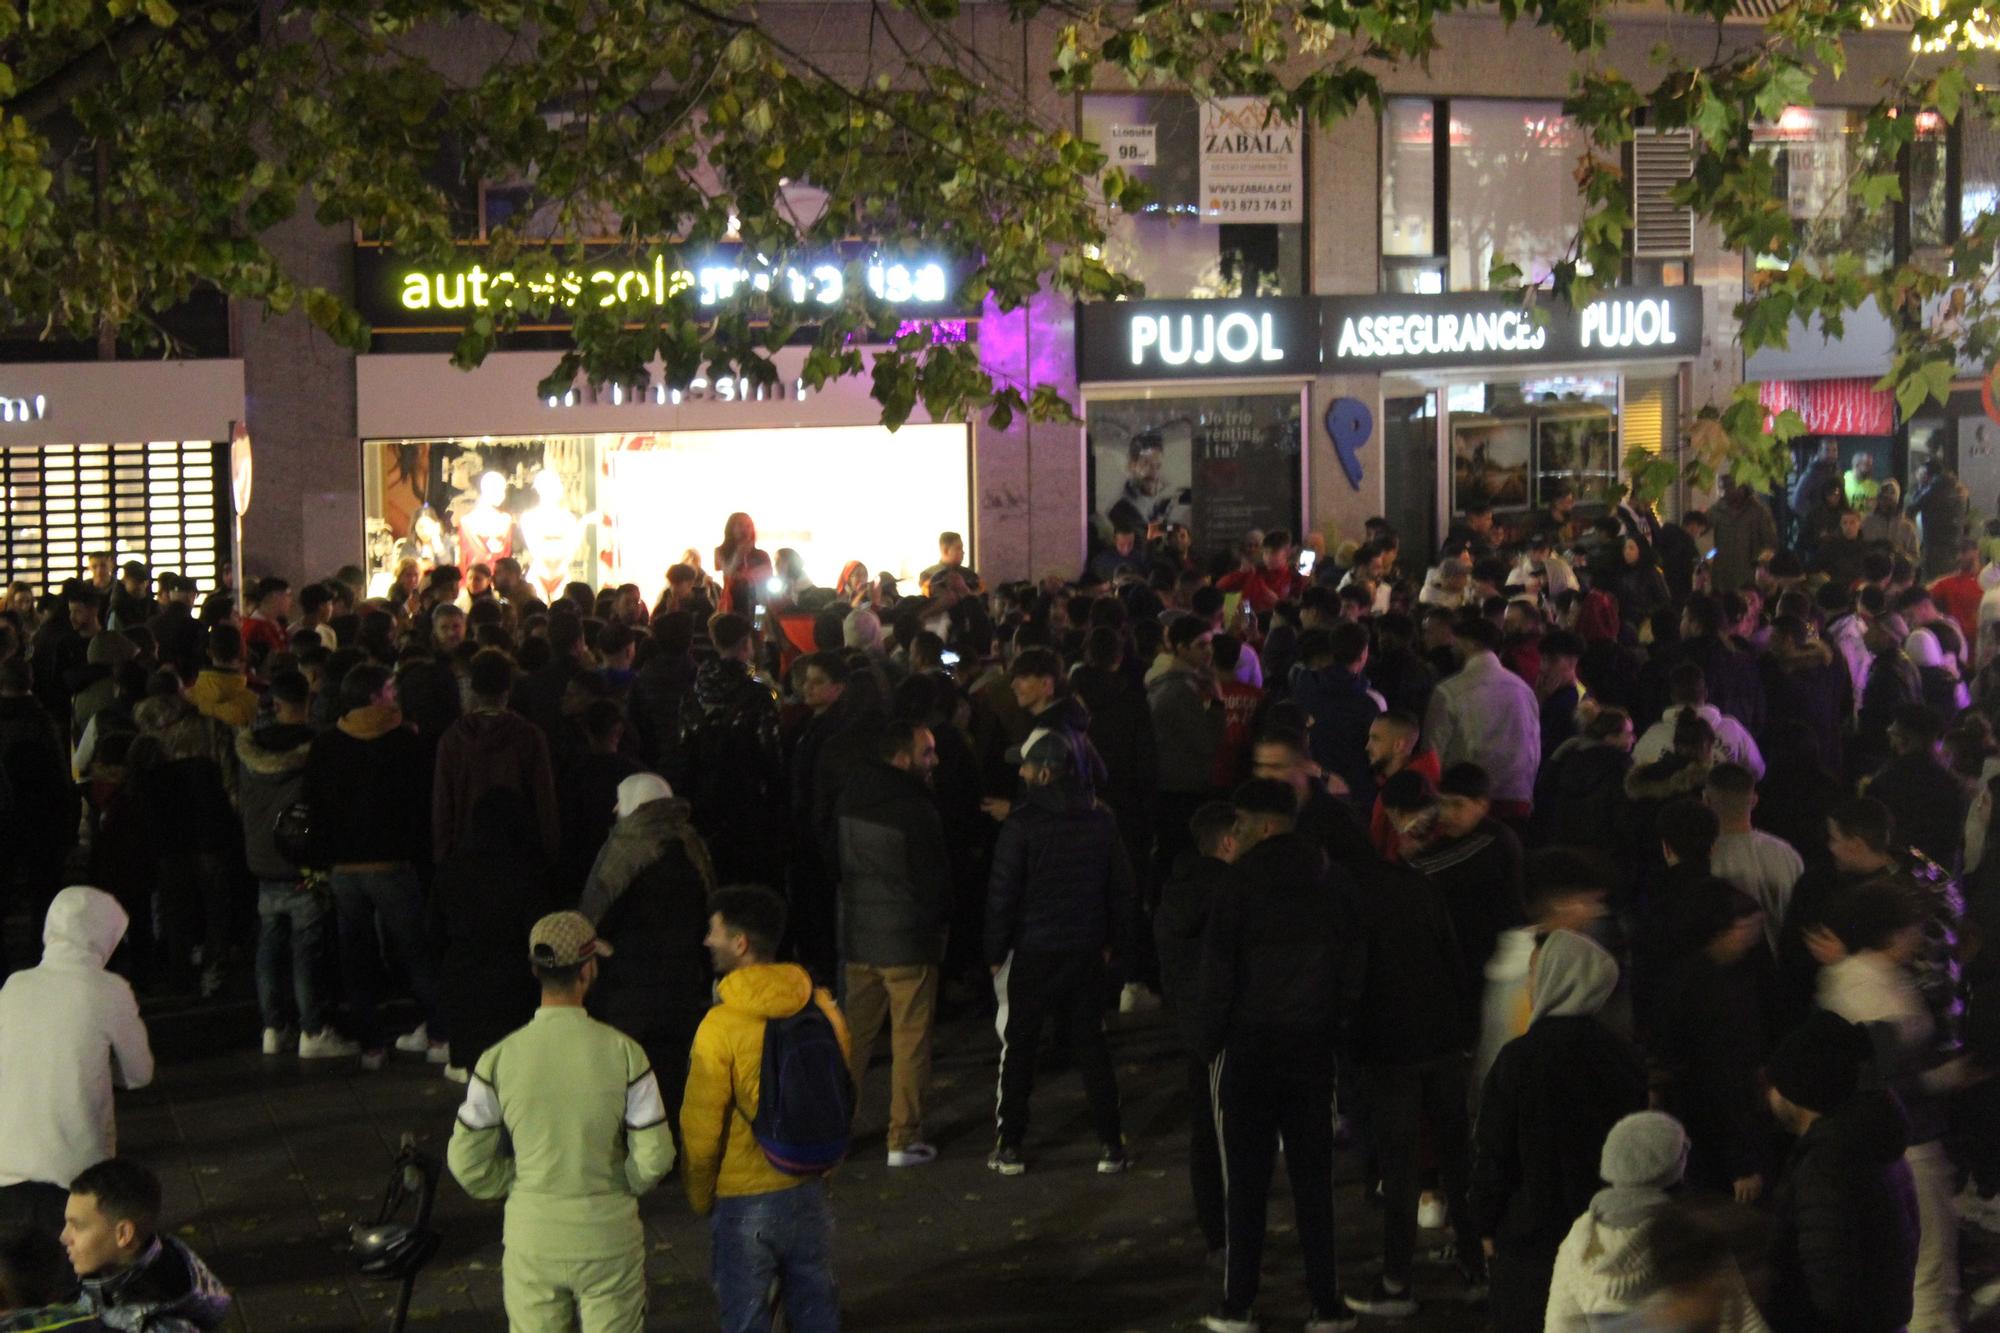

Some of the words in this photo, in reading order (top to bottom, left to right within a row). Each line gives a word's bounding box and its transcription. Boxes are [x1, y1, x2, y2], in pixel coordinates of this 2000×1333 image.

[1119, 145, 1138, 160] 98
[1204, 134, 1293, 154] ZABALA
[1222, 200, 1237, 212] 93
[1240, 200, 1260, 212] 873
[1264, 200, 1277, 212] 74
[1280, 200, 1292, 212] 21
[1582, 299, 1677, 348] PUJOL
[1131, 312, 1284, 365] PUJOL
